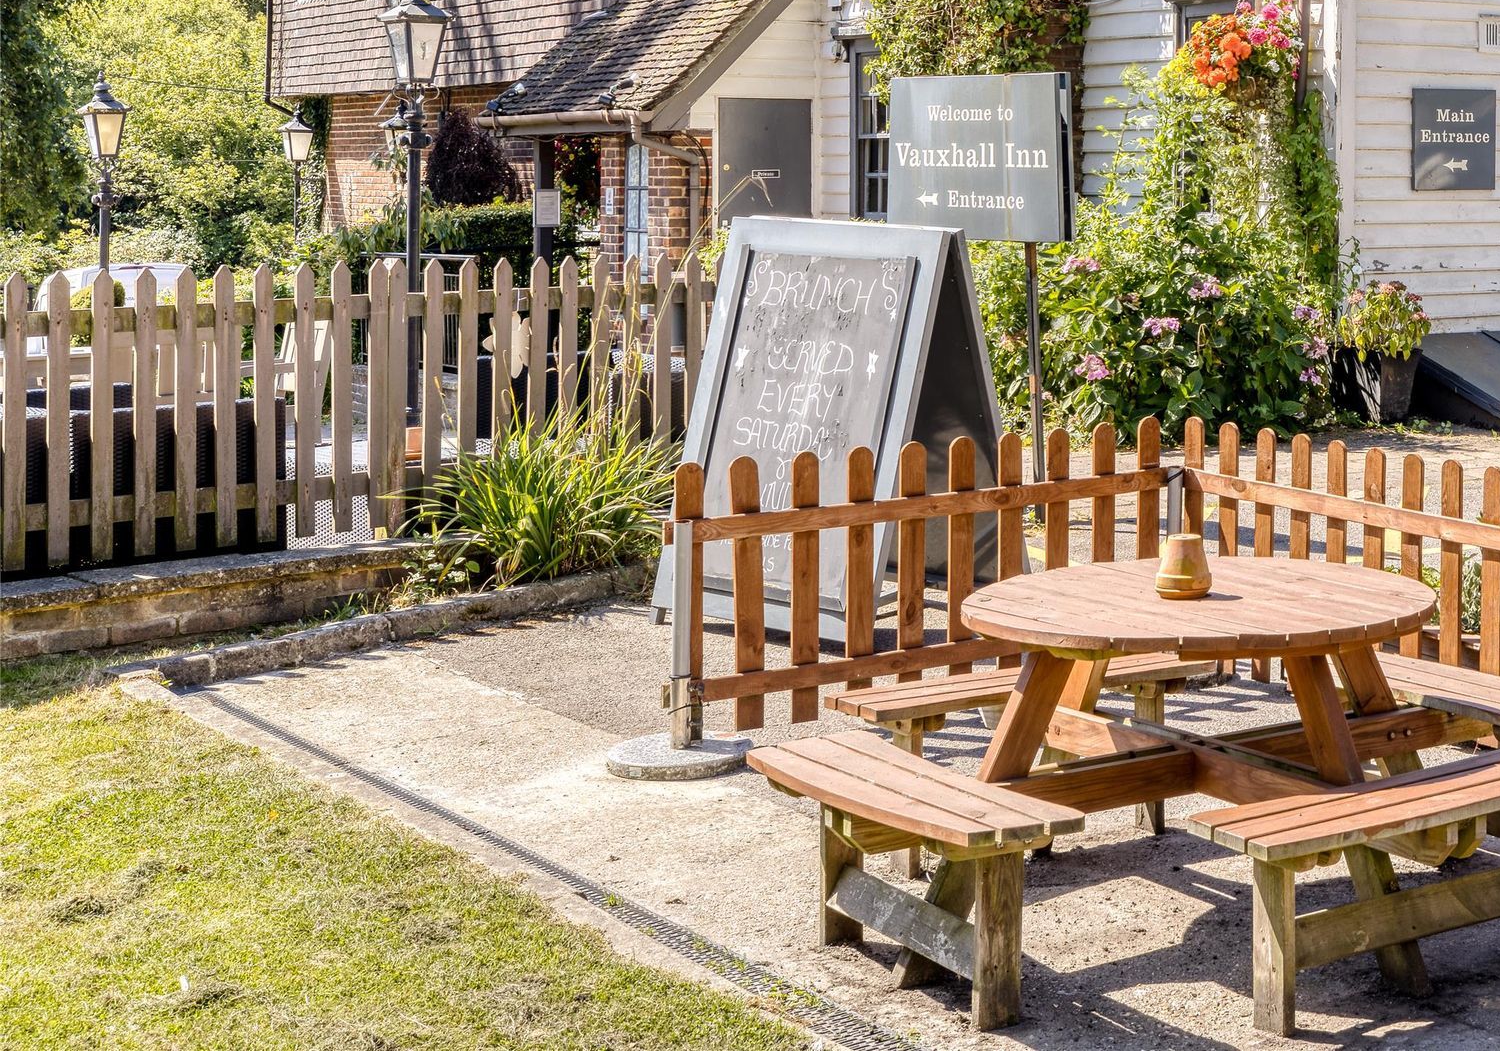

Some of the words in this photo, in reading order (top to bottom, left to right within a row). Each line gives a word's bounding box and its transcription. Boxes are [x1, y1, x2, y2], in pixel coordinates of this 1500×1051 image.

[927, 105, 992, 122] Welcome
[998, 104, 1014, 121] to
[1436, 108, 1475, 123] Main
[1420, 129, 1490, 143] Entrance
[895, 142, 996, 168] Vauxhall
[1005, 142, 1049, 168] Inn
[947, 190, 1025, 210] Entrance
[757, 379, 838, 423] EVERY
